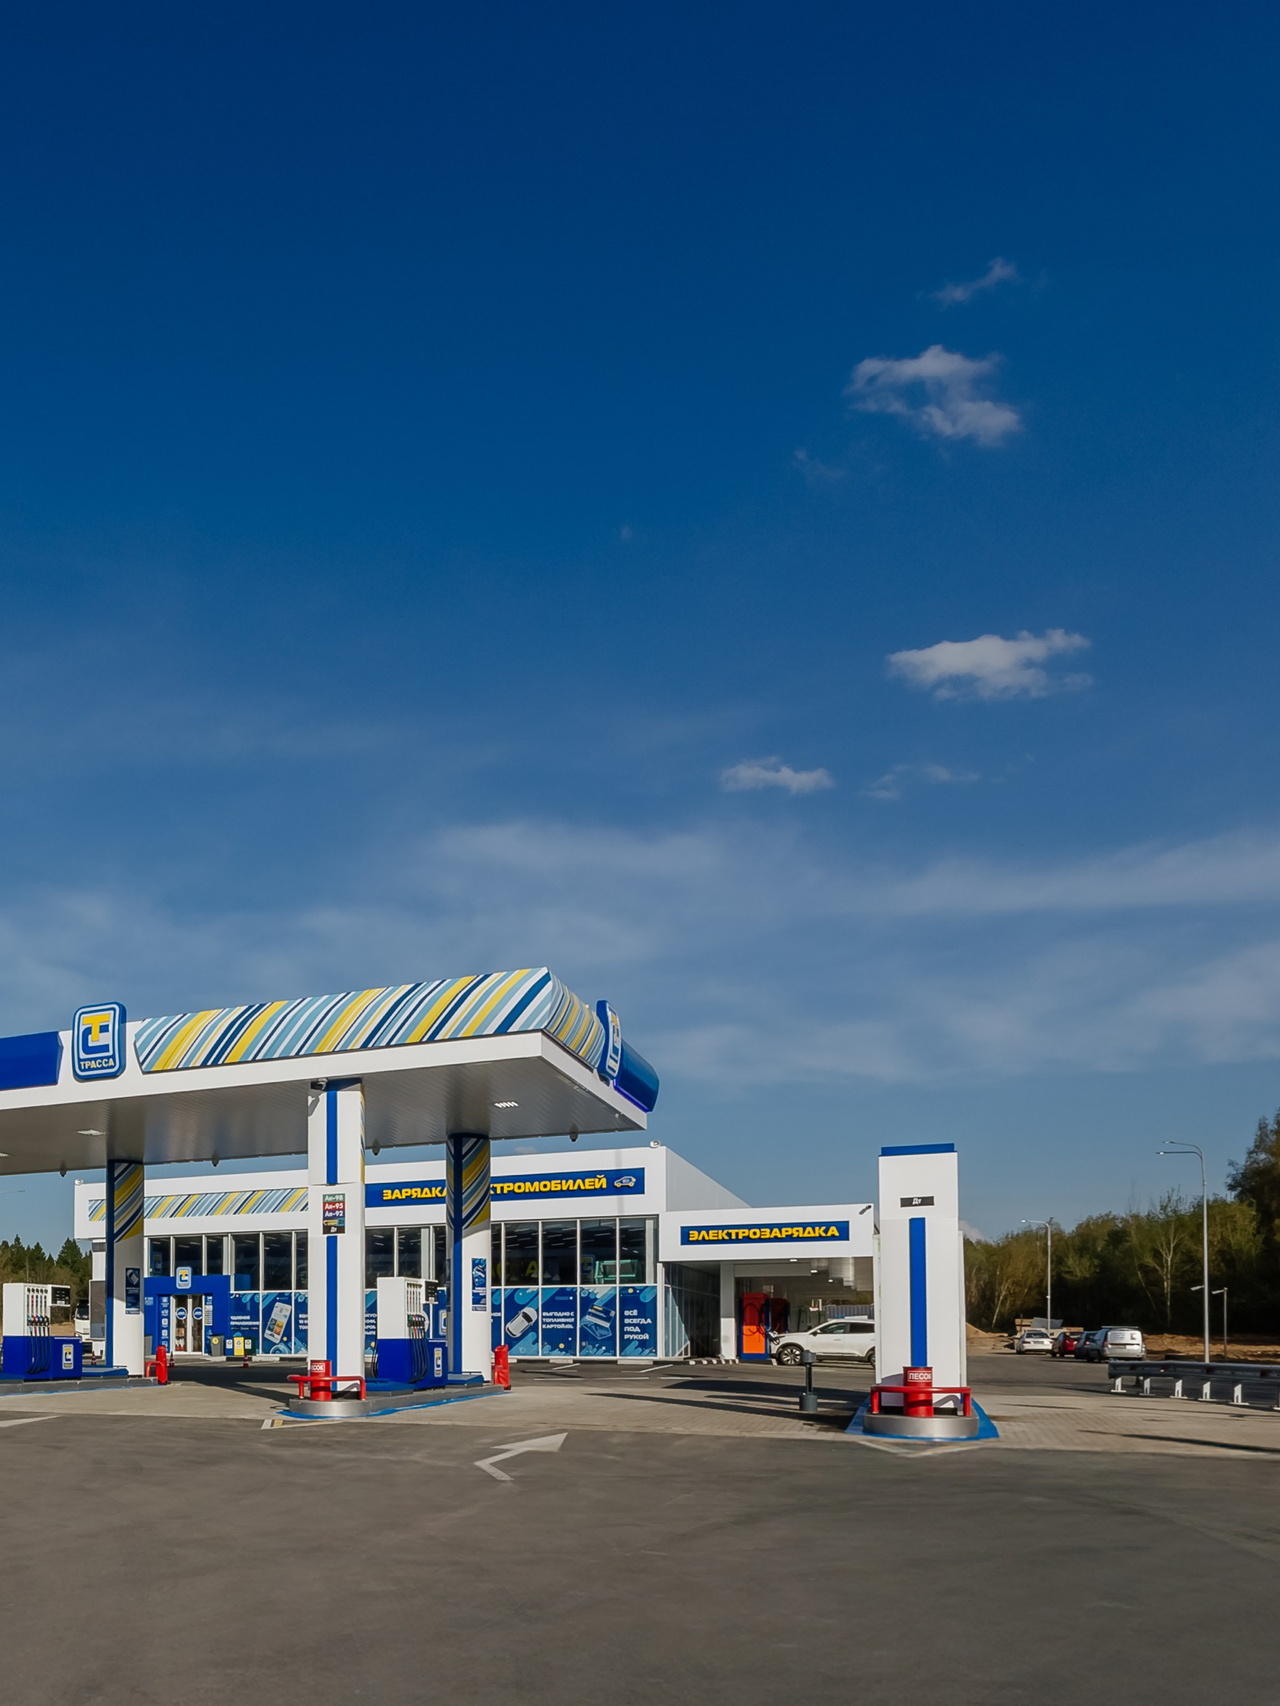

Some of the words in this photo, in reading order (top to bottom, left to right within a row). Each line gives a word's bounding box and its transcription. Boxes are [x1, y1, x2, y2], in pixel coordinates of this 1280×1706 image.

[80, 1058, 115, 1069] ТРАССА
[325, 1202, 344, 1210] Аи-95
[688, 1225, 840, 1241] ЭЛЕКТРОЗАРЯДКА
